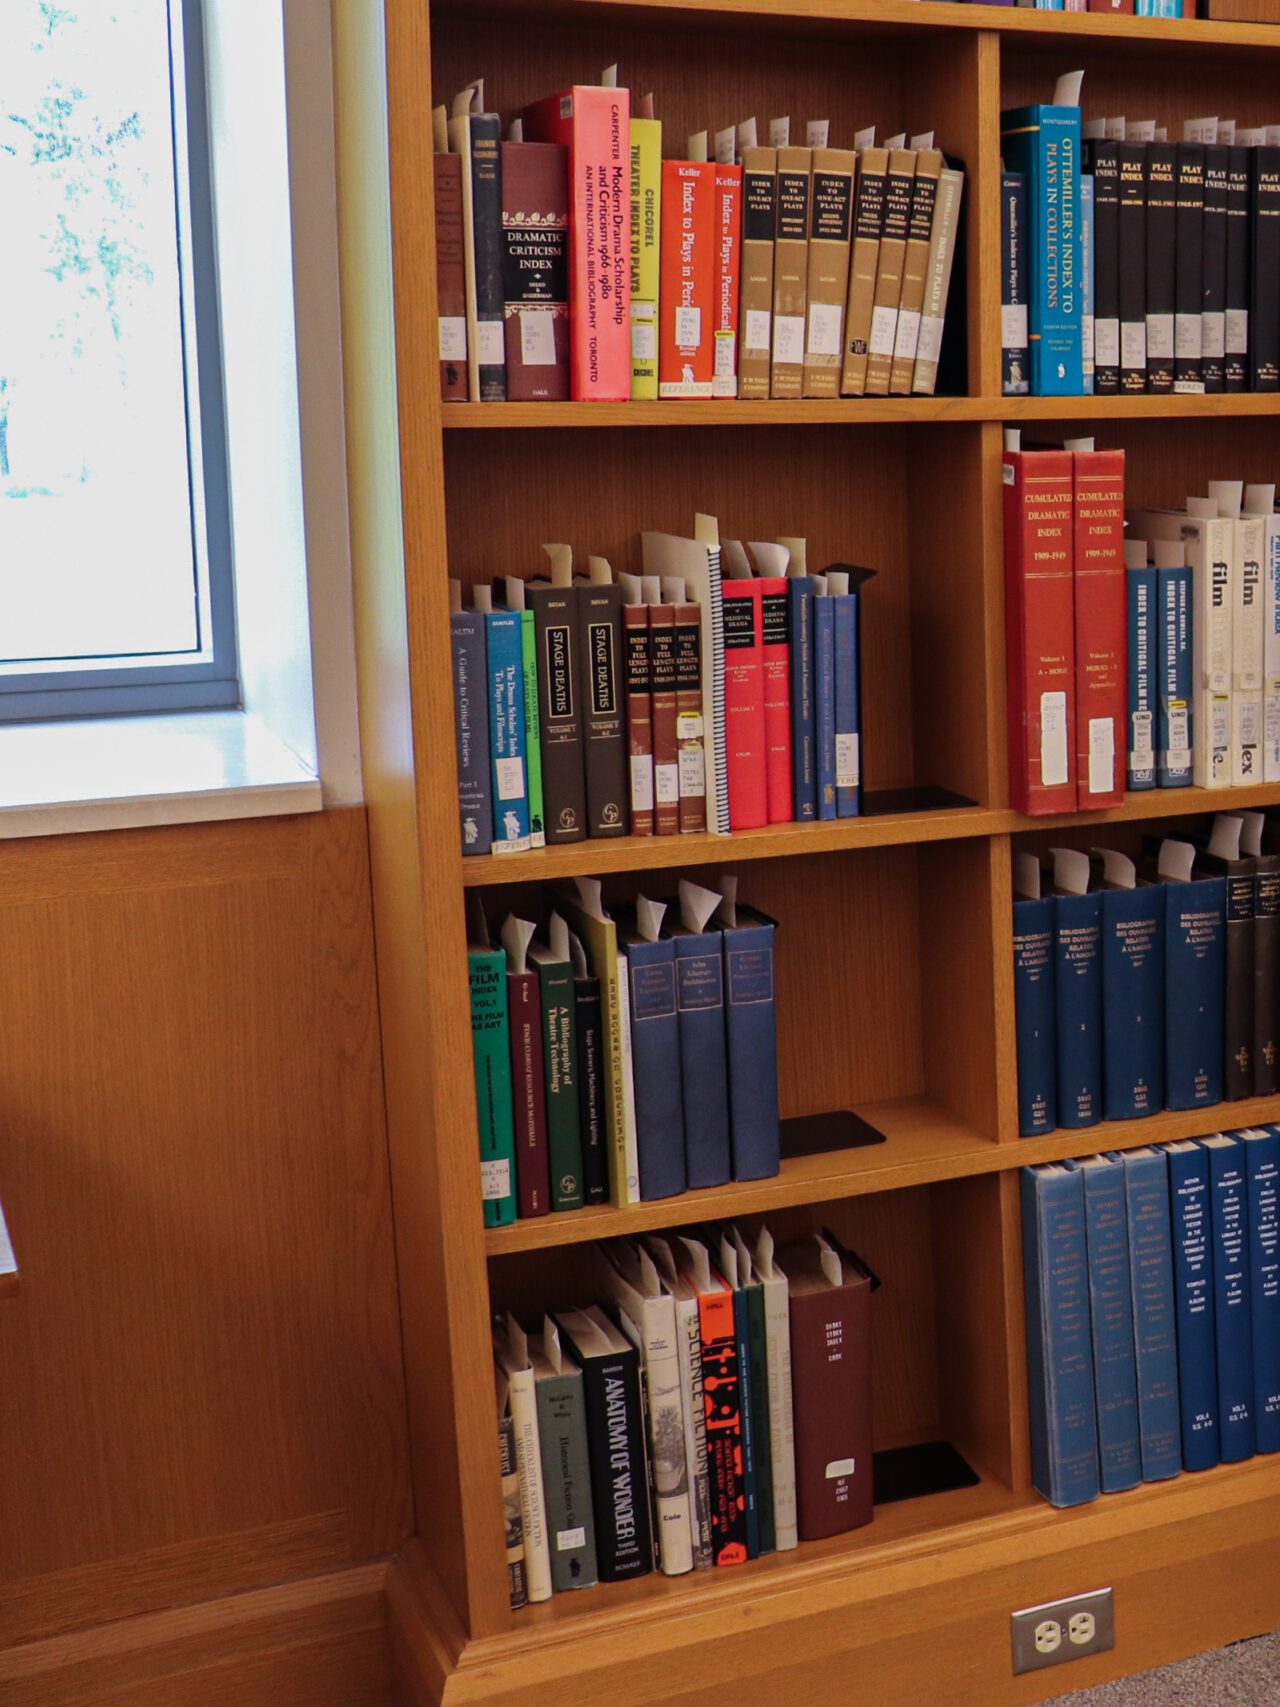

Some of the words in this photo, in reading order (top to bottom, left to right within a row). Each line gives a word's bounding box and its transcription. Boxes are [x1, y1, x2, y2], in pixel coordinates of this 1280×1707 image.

[611, 104, 620, 160] CARPENTER
[585, 165, 593, 181] AN
[630, 145, 641, 198] THEATER
[679, 168, 701, 178] Keller
[1047, 143, 1058, 184] PLAYS
[1095, 169, 1118, 177] INDEX
[1097, 160, 1117, 168] PLAY
[1122, 163, 1142, 171] PLAY
[1152, 163, 1172, 171] PLAY
[1182, 165, 1203, 173] PLAY
[1207, 171, 1226, 179] PLAY
[599, 165, 610, 188] and
[716, 178, 742, 187] Keller
[821, 180, 845, 188] INDEX
[891, 180, 909, 189] INDEX
[917, 182, 935, 190] INDEX
[1121, 173, 1144, 181] INDEX
[1150, 173, 1174, 181] INDEX
[1180, 176, 1204, 184] INDEX
[1230, 173, 1247, 181] PLAY
[1260, 174, 1279, 182] PLAY
[612, 166, 624, 213] Modern
[682, 182, 696, 214] Index
[817, 195, 847, 203] ONE-ACT
[1047, 188, 1058, 204] IN
[1062, 137, 1073, 241] OTTEMILLER'S
[599, 190, 611, 242] Criticism
[630, 200, 641, 236] INDEX
[643, 188, 655, 248] CHICOREL
[722, 194, 735, 225] Index
[914, 204, 932, 212] PLAYS
[586, 183, 595, 257] INTERNATIONAL
[682, 217, 692, 229] to
[508, 233, 563, 242] DRAMATIC
[613, 215, 625, 254] Drama
[631, 238, 641, 254] TO
[509, 246, 562, 256] CRITICISM
[679, 231, 696, 263] Plays
[720, 237, 733, 267] Plays
[1047, 208, 1058, 308] COLLECTIONS
[520, 259, 552, 269] INDEX
[631, 257, 641, 293] PLAYS
[682, 265, 694, 277] in
[1062, 244, 1074, 288] INDEX
[587, 260, 598, 329] BIBLIOGRAPHY
[613, 257, 627, 325] Scholarship
[1062, 296, 1073, 314] TO
[590, 336, 599, 383] TORONTO
[1025, 493, 1073, 503] CUMULATED
[1077, 492, 1124, 502] CUMULATED
[1028, 511, 1070, 520] DRAMATIC
[1080, 509, 1121, 518] DRAMATIC
[1038, 528, 1062, 537] INDEX
[1089, 526, 1113, 535] INDEX
[1167, 580, 1176, 609] INDEX
[1212, 560, 1228, 607] film
[1243, 560, 1259, 606] film
[1137, 584, 1148, 613] INDEX
[1137, 615, 1148, 627] TO
[1167, 611, 1176, 622] TO
[553, 631, 565, 667] STAGE
[596, 628, 608, 664] STAGE
[1137, 628, 1148, 672] CRITICAL
[1167, 624, 1177, 667] CRITICAL
[458, 657, 468, 685] Guide
[506, 664, 516, 683] The
[1168, 668, 1177, 692] FILM
[460, 687, 468, 698] to
[494, 683, 505, 704] Plays
[507, 683, 517, 706] Drama
[555, 670, 567, 713] DEATHS
[597, 666, 610, 709] DEATHS
[1138, 673, 1148, 698] FILM
[460, 698, 470, 730] Critical
[462, 732, 472, 768] Reviews
[470, 972, 500, 985] FILM
[560, 1006, 569, 1014] A
[549, 1006, 559, 1042] Theatre
[561, 1016, 572, 1073] Bibliography
[551, 1042, 561, 1094] Technology
[563, 1074, 573, 1085] of
[687, 1328, 705, 1402] SCIENCE
[605, 1378, 629, 1450] ANATOMY
[694, 1408, 710, 1477] FICTION
[559, 1437, 571, 1479] Historical
[611, 1452, 631, 1472] OF
[613, 1471, 636, 1540] WONDER
[663, 1513, 682, 1521] Cole
